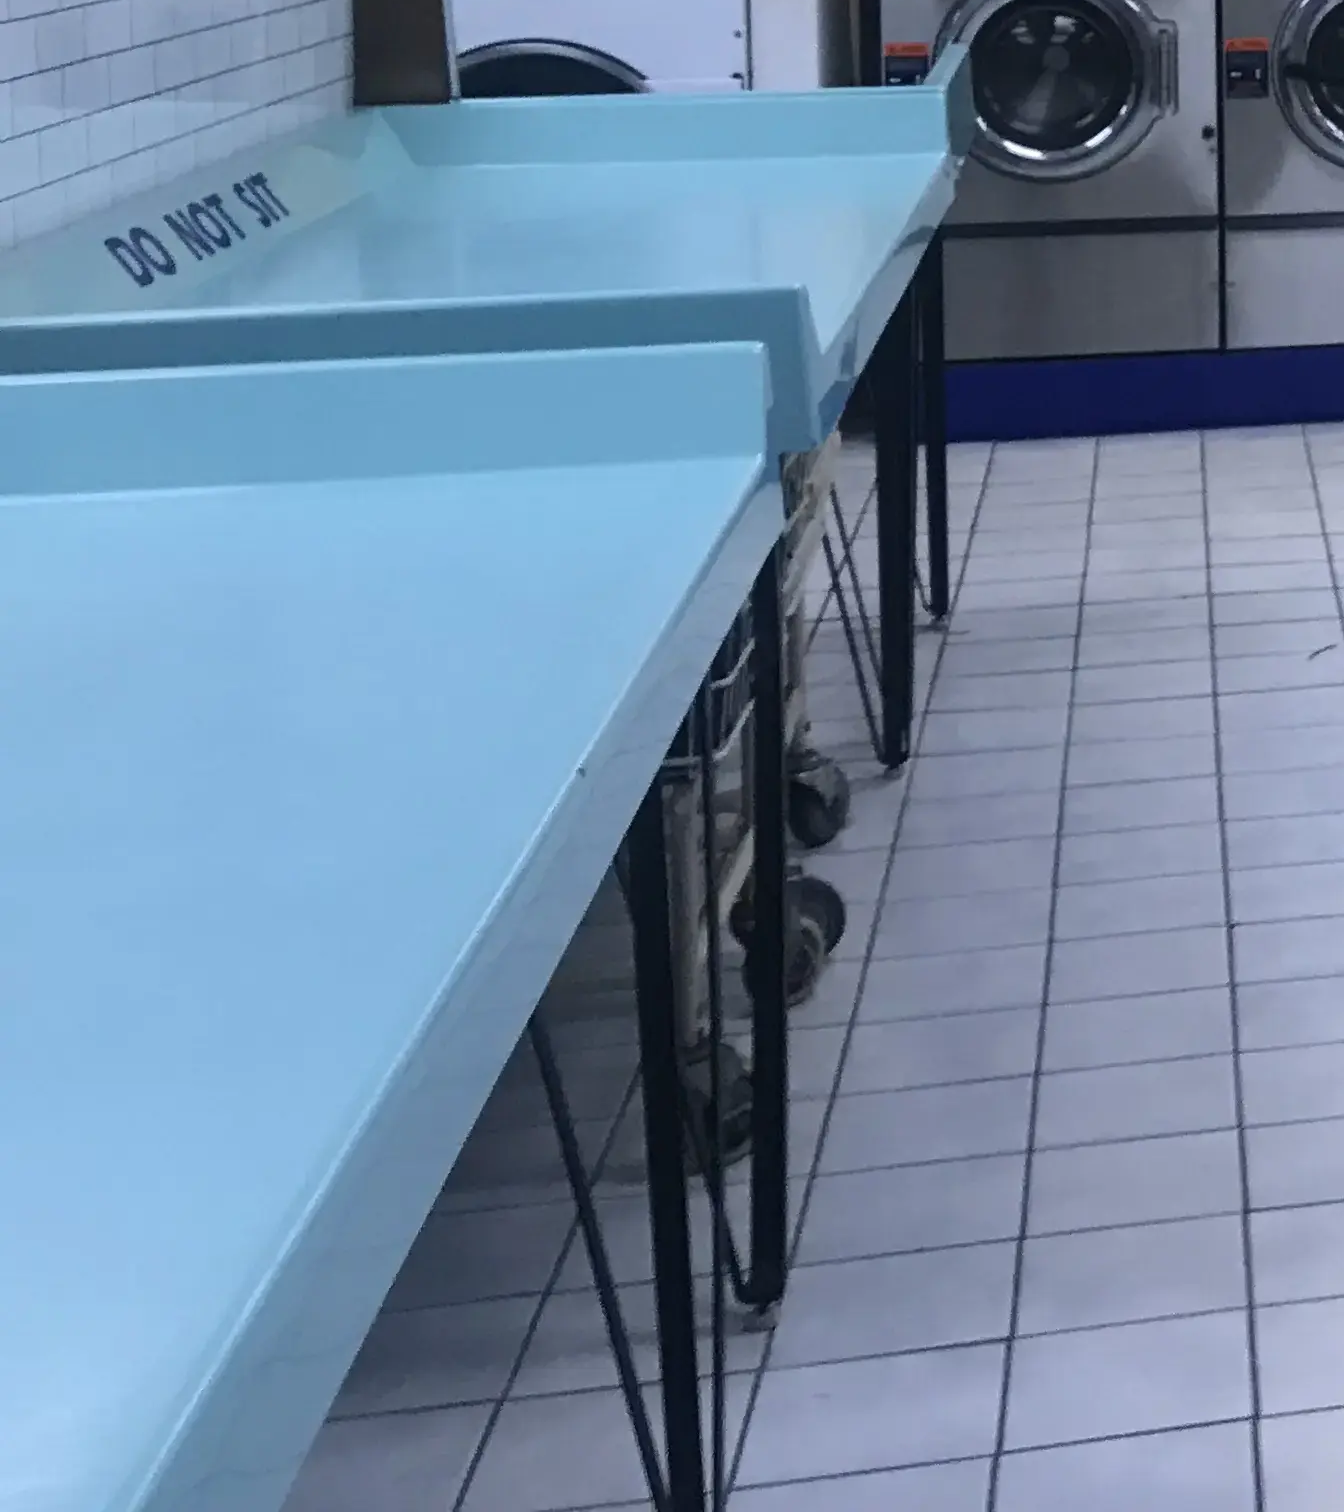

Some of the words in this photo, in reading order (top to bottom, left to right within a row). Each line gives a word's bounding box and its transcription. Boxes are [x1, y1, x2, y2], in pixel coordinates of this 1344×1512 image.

[104, 226, 177, 288] DO
[163, 192, 247, 261] NOT
[232, 171, 290, 228] SIT
